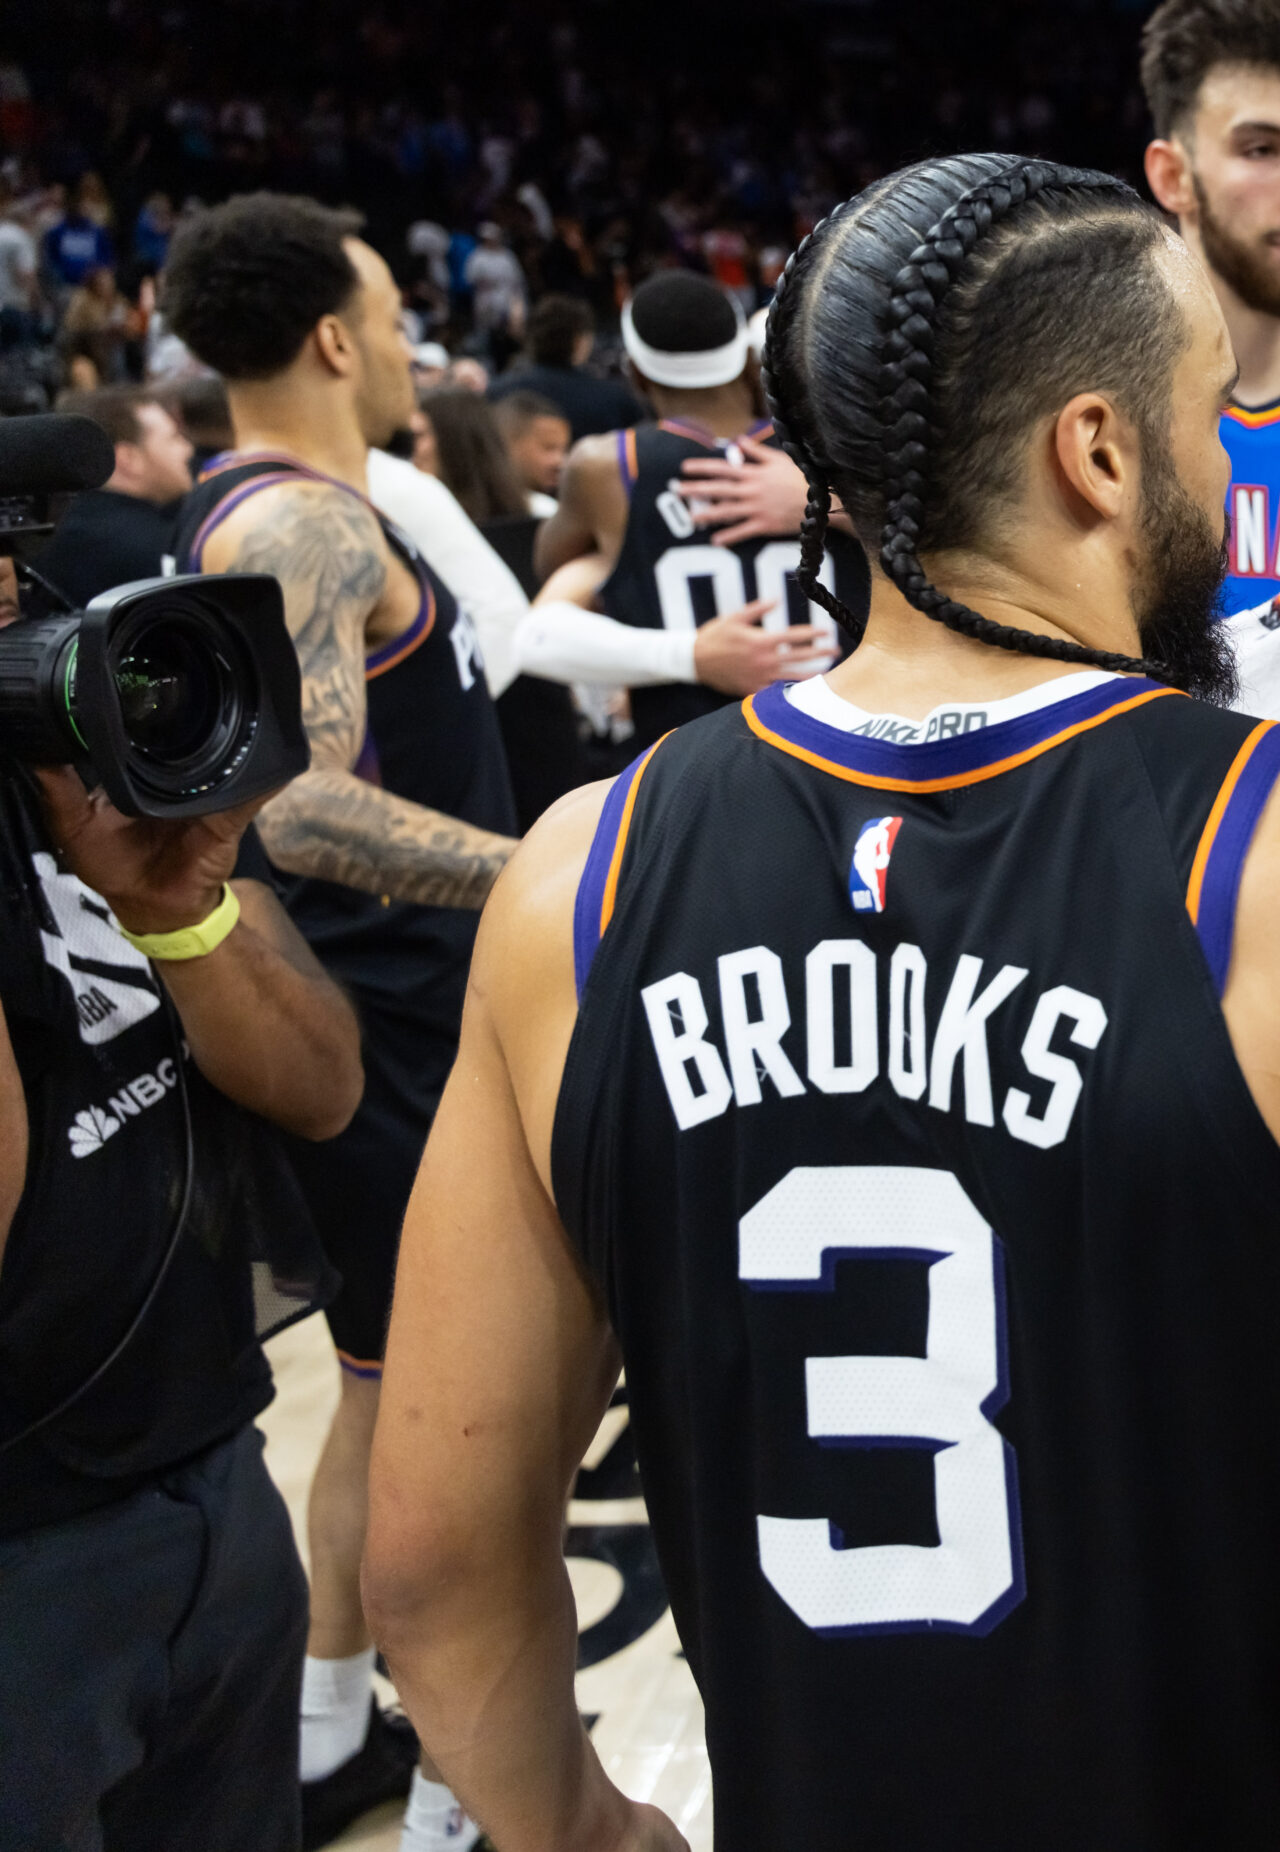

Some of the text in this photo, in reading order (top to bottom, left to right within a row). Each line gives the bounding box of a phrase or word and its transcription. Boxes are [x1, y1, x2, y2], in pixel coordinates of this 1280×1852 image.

[108, 1057, 177, 1124] NBC
[641, 939, 1108, 1149] BROOKS
[739, 1166, 1025, 1637] 3
